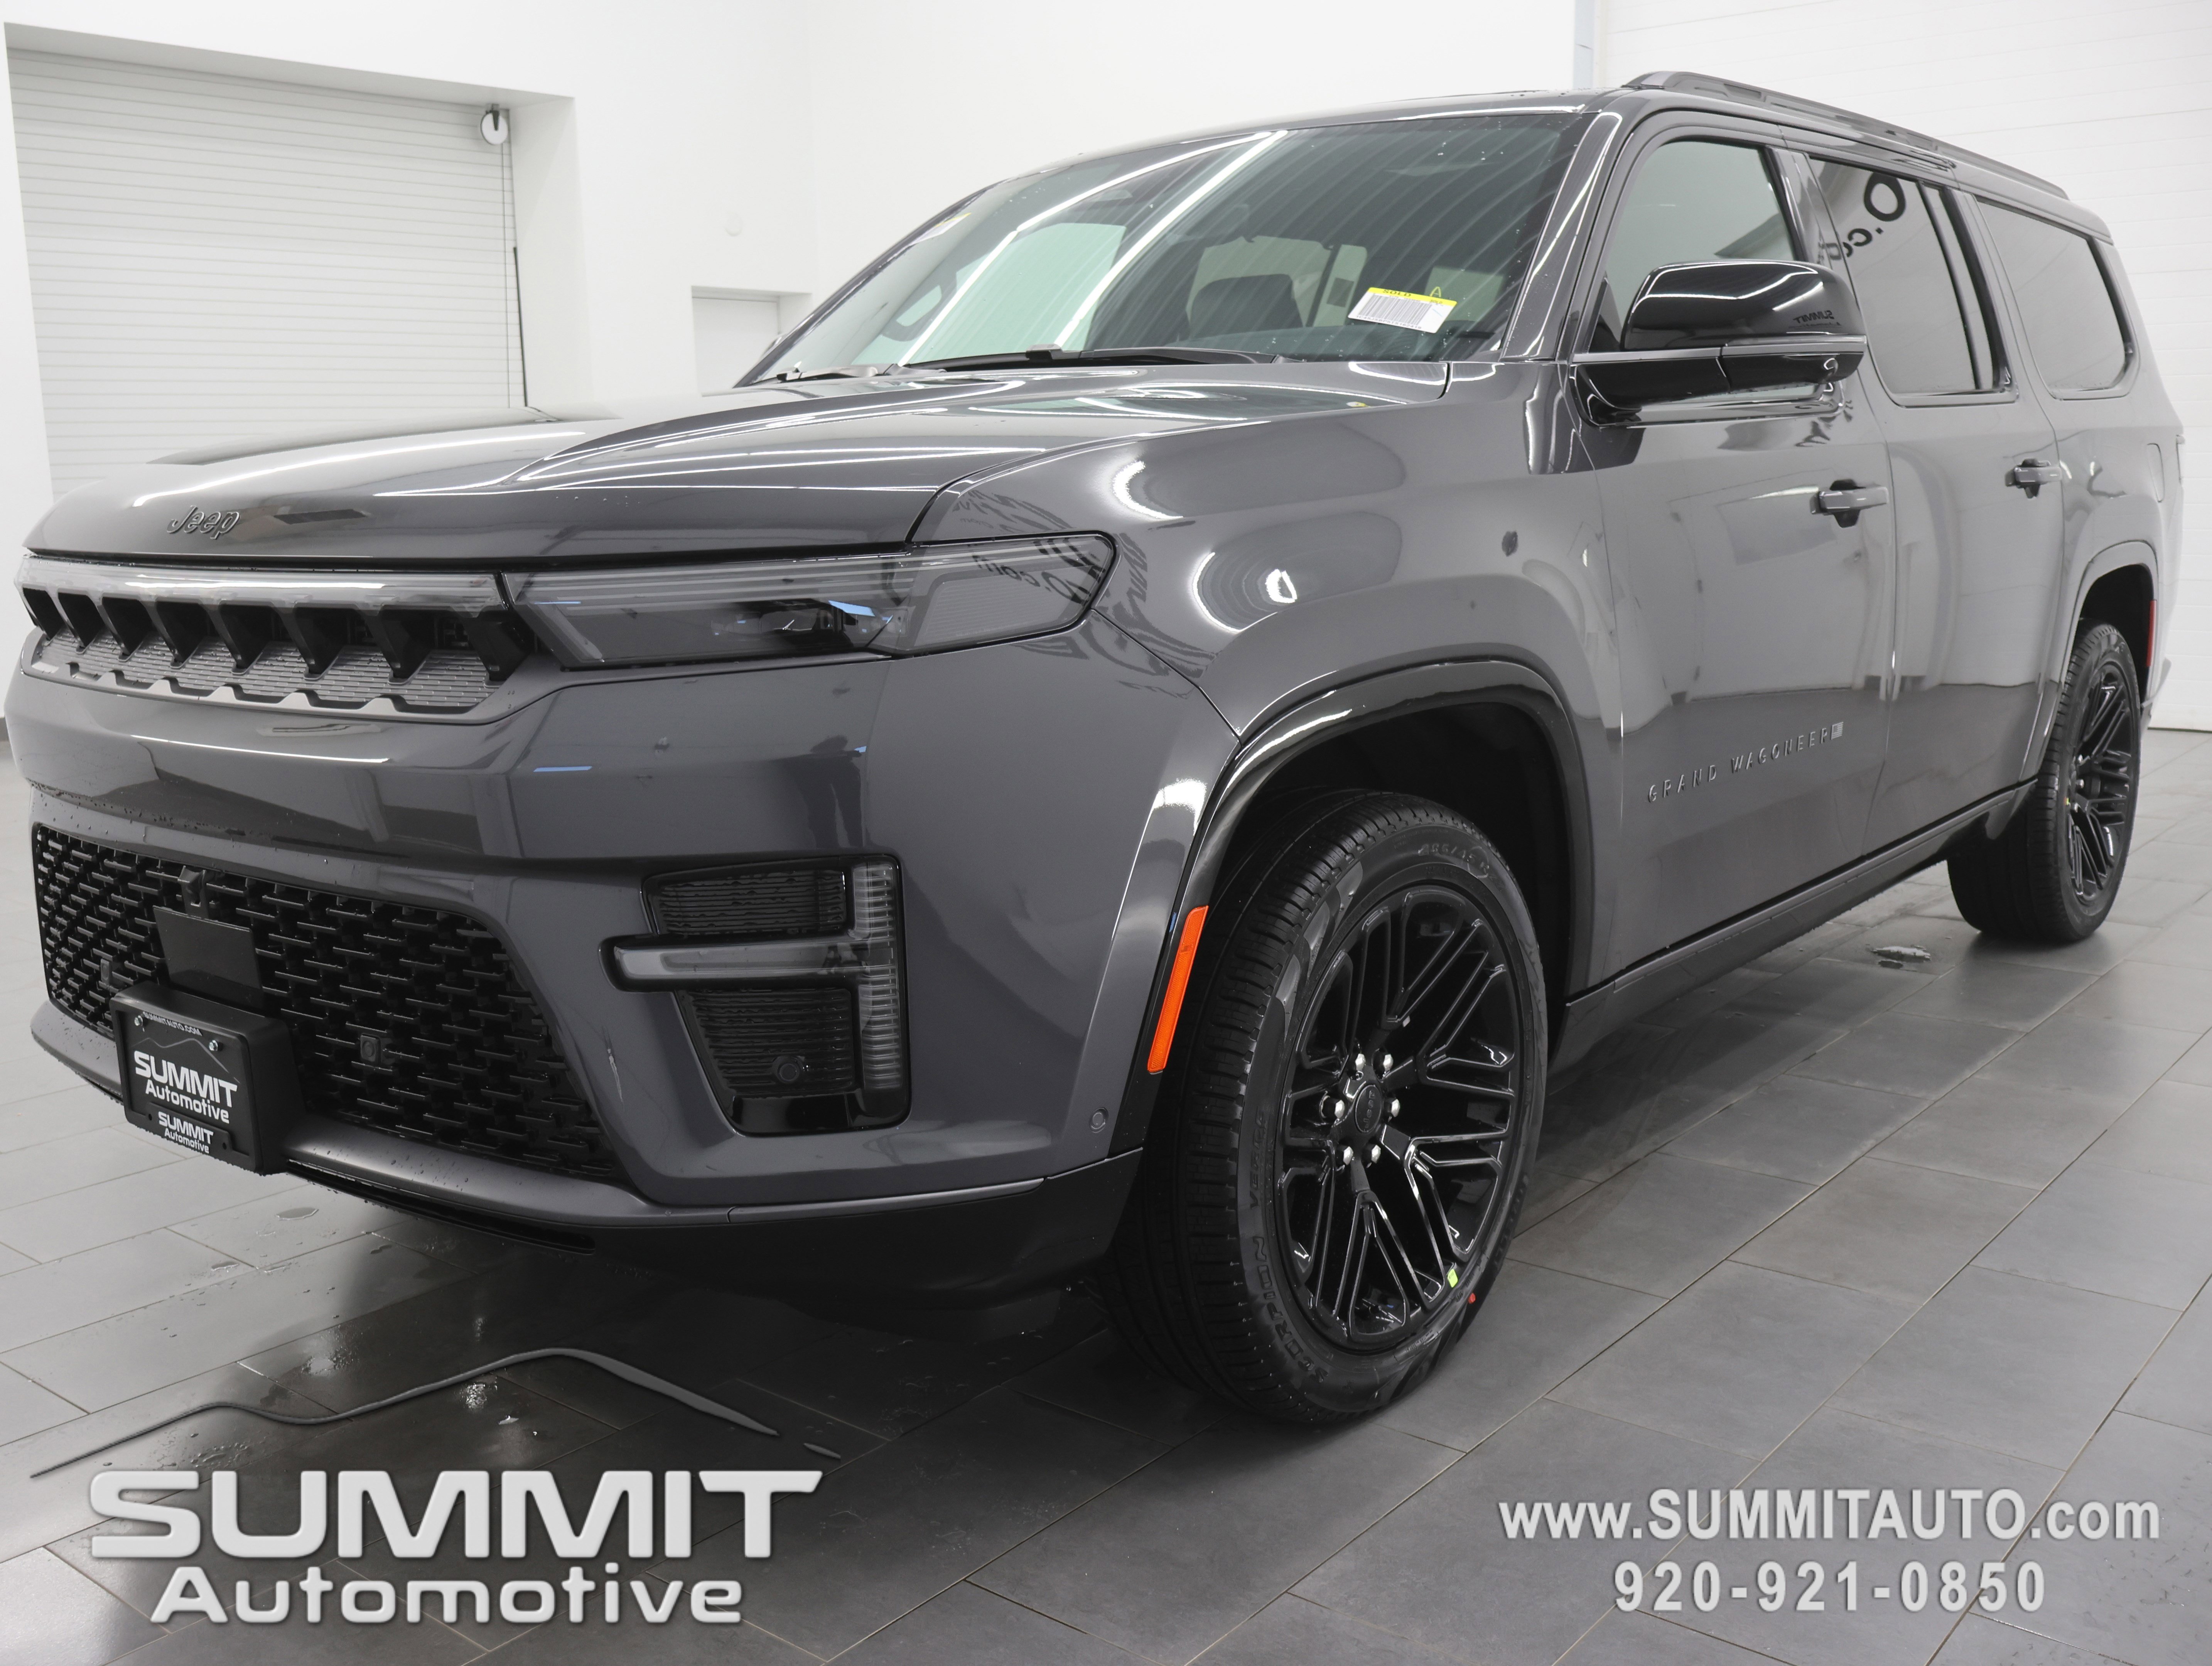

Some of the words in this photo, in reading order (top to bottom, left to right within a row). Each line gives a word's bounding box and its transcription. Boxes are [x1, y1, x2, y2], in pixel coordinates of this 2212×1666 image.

[1382, 289, 1412, 298] SOLD
[166, 505, 241, 540] Jeep
[1648, 765, 1717, 803] GRAND
[1731, 728, 1828, 774] WAGONEER
[134, 1050, 238, 1108] SUMMIT
[145, 1079, 230, 1124] Automotive
[158, 1111, 214, 1144] SUMMIT
[164, 1128, 209, 1154] Automotive
[1252, 1236, 1329, 1384] SCORPION
